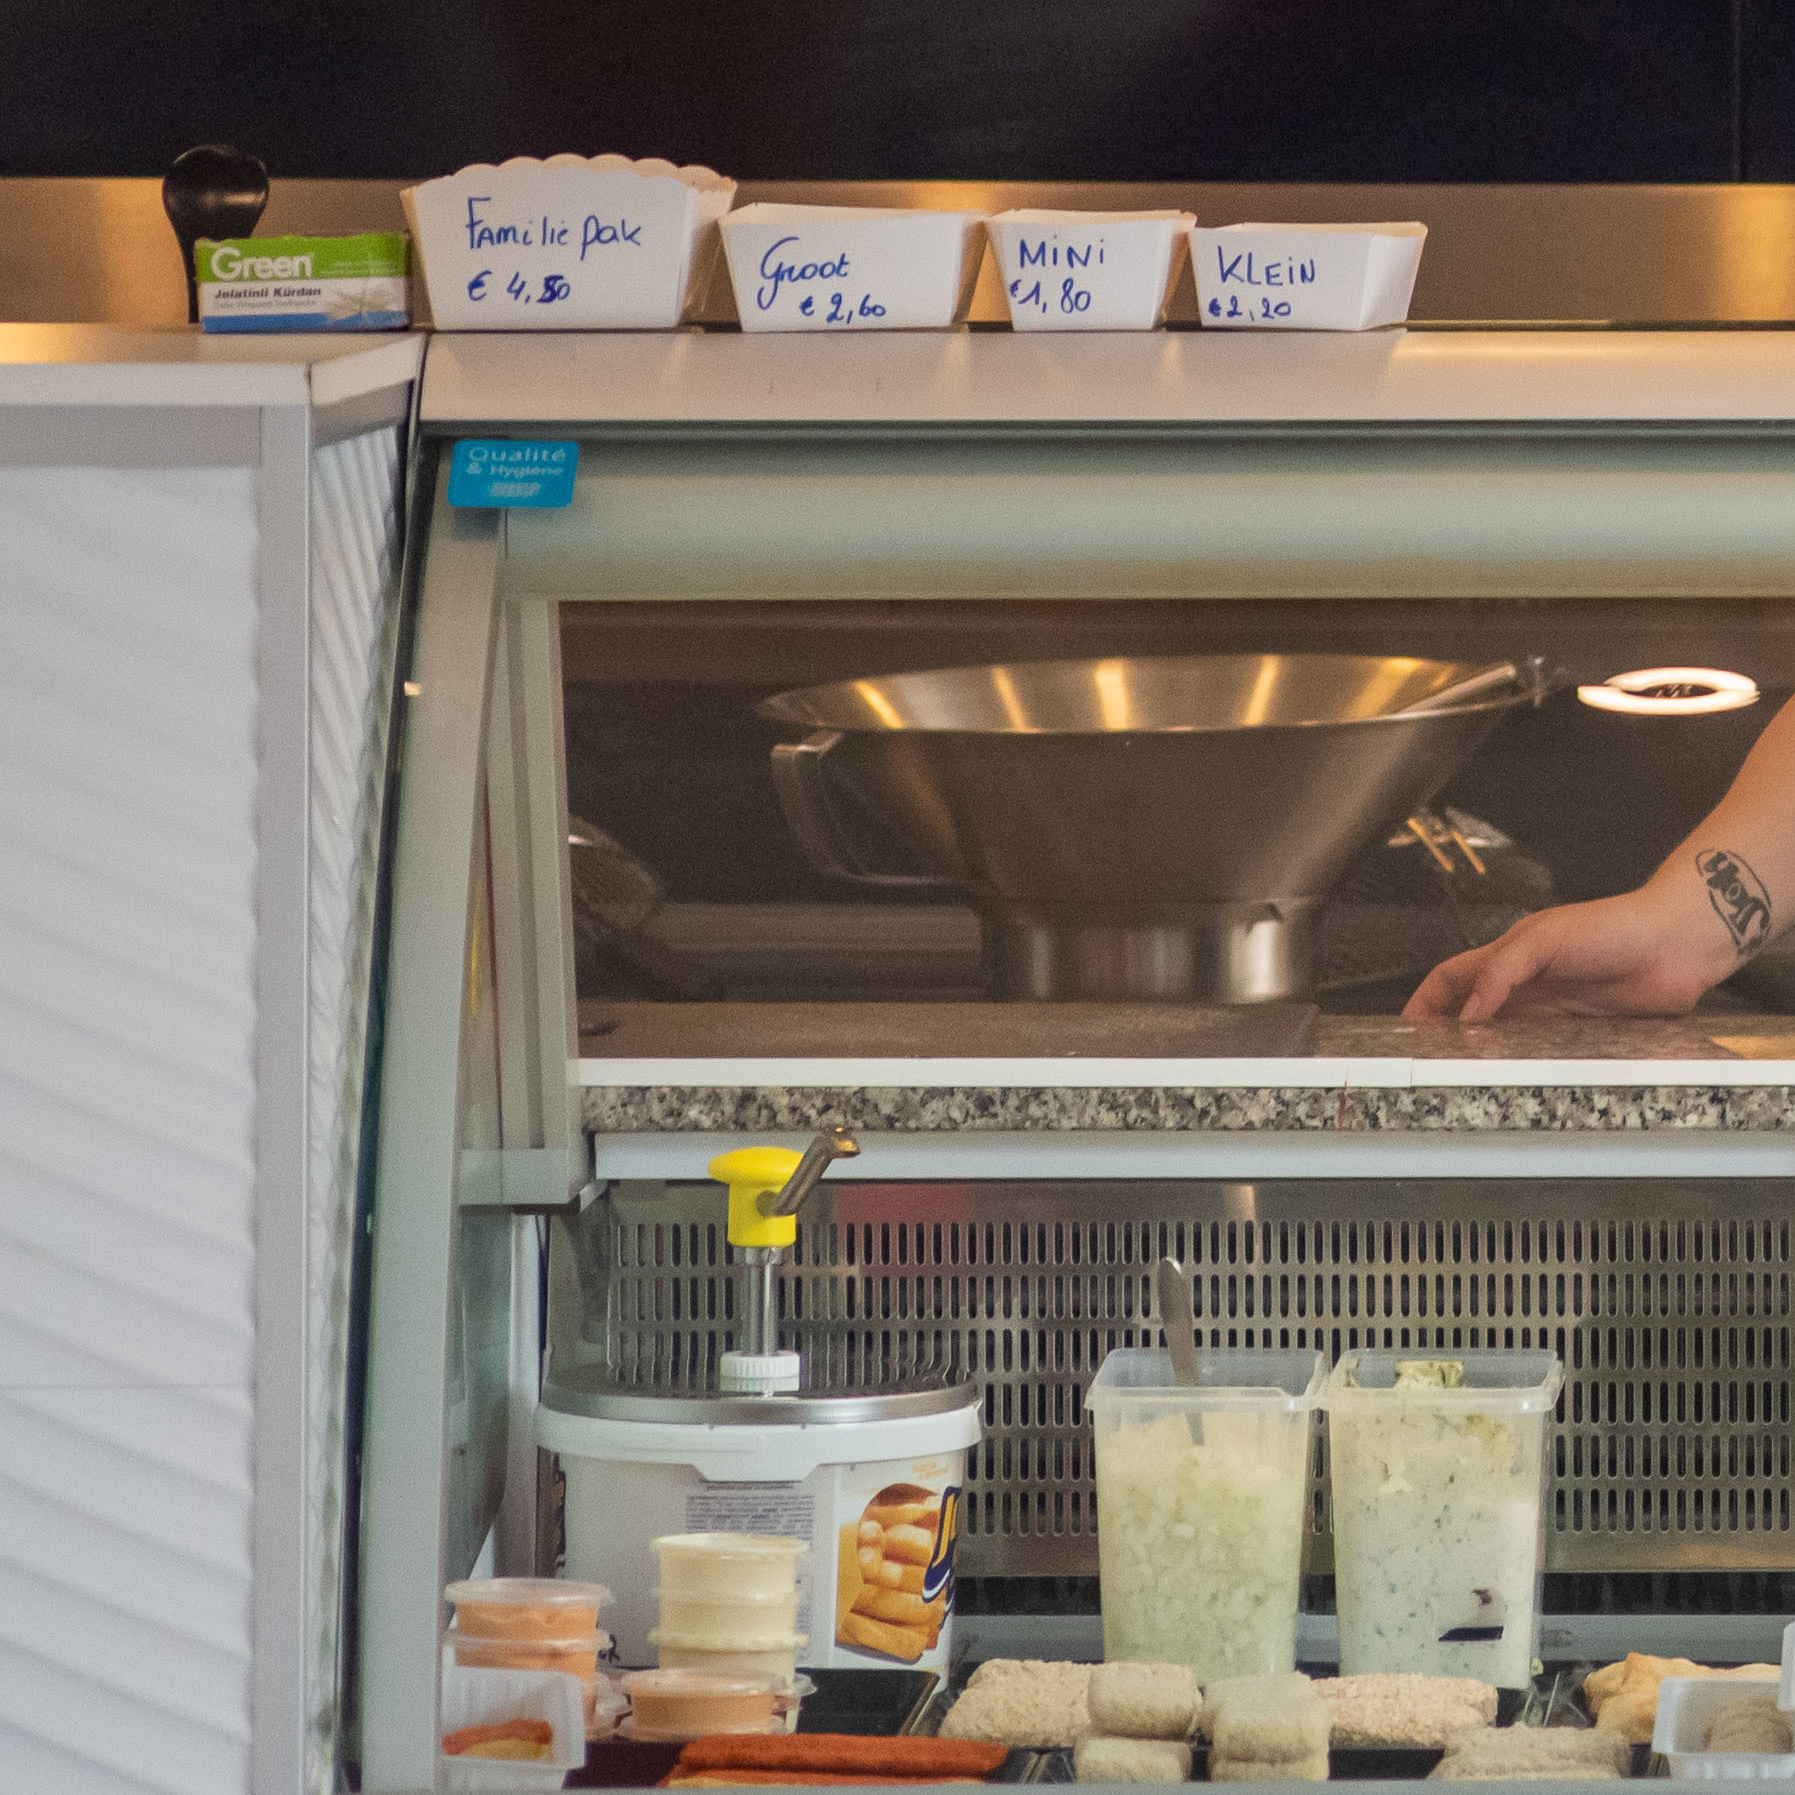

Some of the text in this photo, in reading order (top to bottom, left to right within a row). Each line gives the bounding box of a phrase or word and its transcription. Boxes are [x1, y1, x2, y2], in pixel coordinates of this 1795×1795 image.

[210, 246, 315, 281] Green
[756, 235, 851, 310] Groot
[825, 291, 887, 325] 2,60
[468, 446, 567, 463] Qualité
